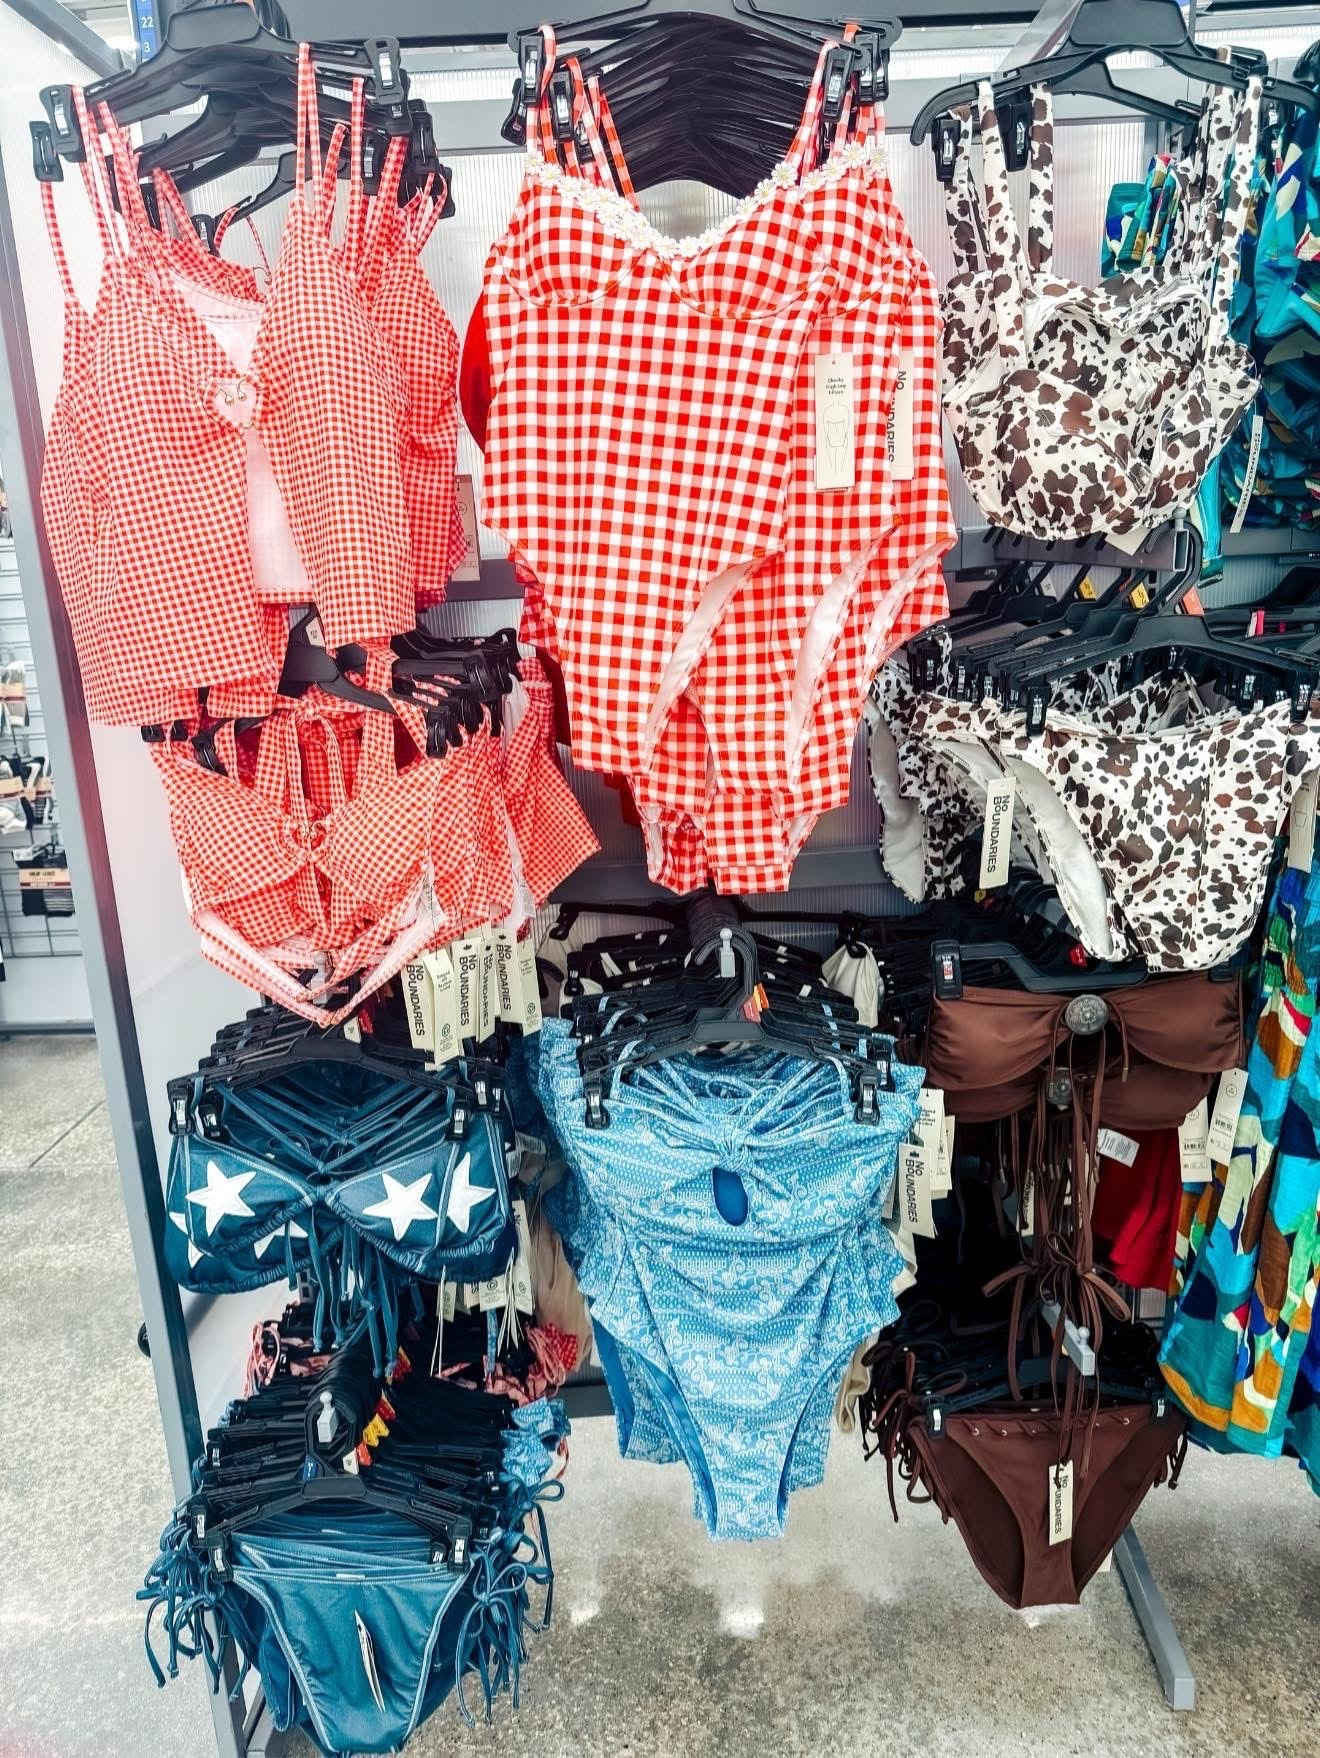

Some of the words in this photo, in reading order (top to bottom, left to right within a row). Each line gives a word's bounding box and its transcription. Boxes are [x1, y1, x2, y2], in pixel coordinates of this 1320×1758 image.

[141, 16, 154, 28] 22
[143, 41, 151, 53] 3
[895, 371, 907, 391] NO
[1001, 794, 1011, 812] NO
[987, 796, 1002, 873] BOUNDARIES
[503, 944, 512, 960] NO
[468, 954, 478, 970] NO
[414, 964, 425, 981] NO
[496, 944, 512, 1011] BOUNDARIES
[459, 956, 470, 1026] BOUNDARIES
[405, 964, 425, 1036] BOUNDARIES
[914, 1160, 925, 1176] NO
[905, 1158, 918, 1223] BOUNDARIES
[1061, 1475, 1069, 1488] NO
